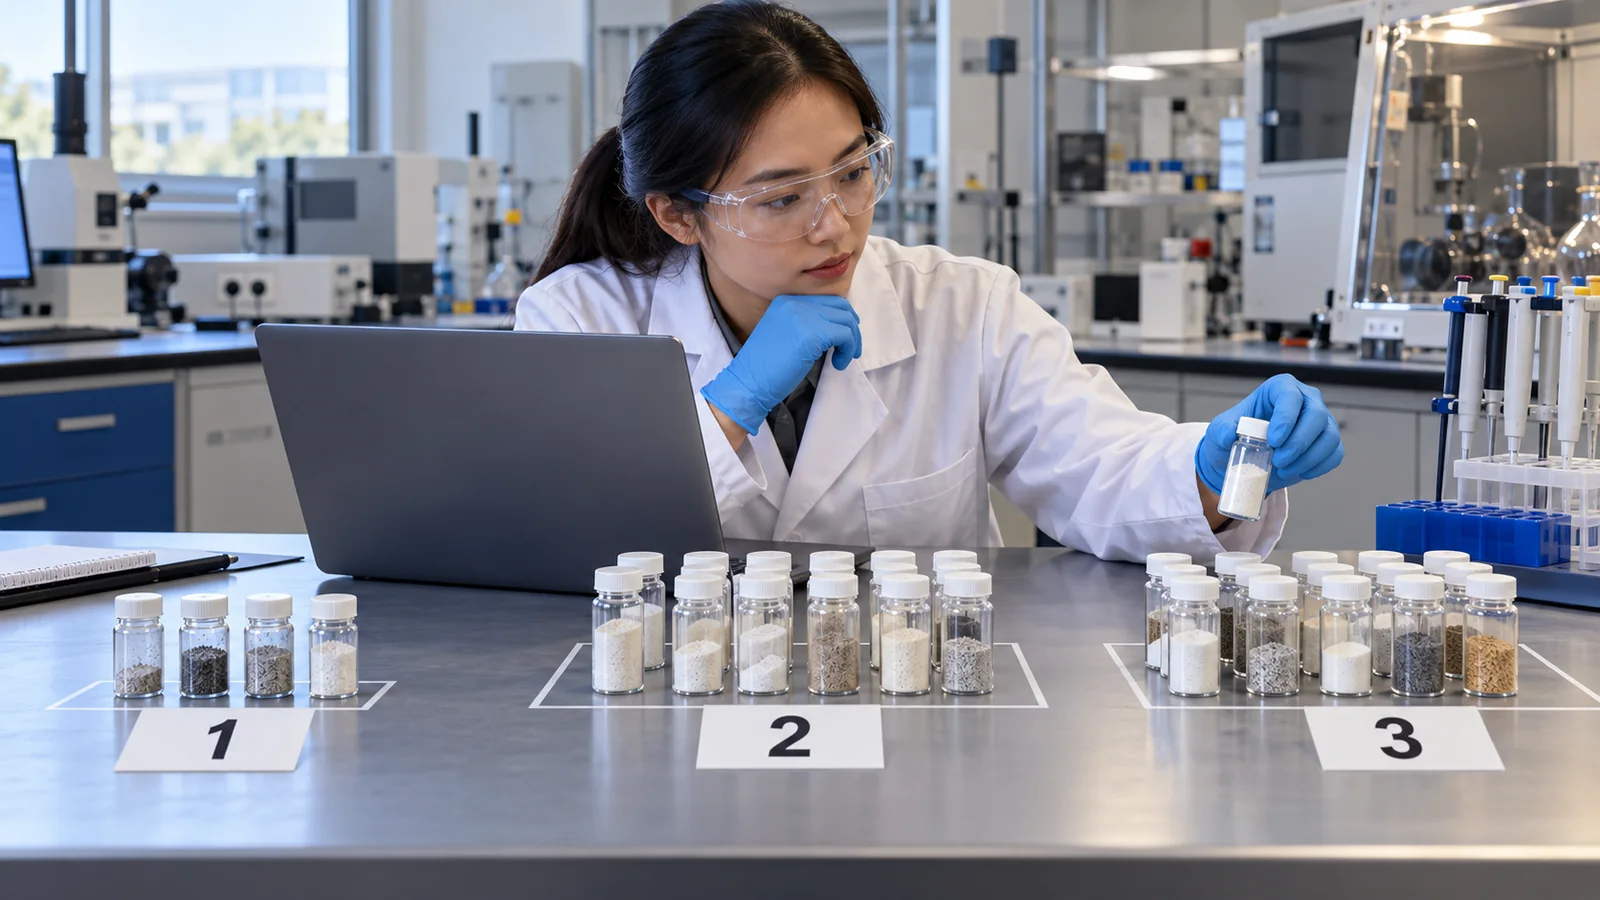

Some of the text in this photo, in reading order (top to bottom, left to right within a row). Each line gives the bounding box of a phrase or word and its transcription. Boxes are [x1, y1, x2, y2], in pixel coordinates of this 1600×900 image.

[208, 719, 238, 760] 1
[768, 715, 811, 757] 2
[1375, 717, 1423, 760] 3
